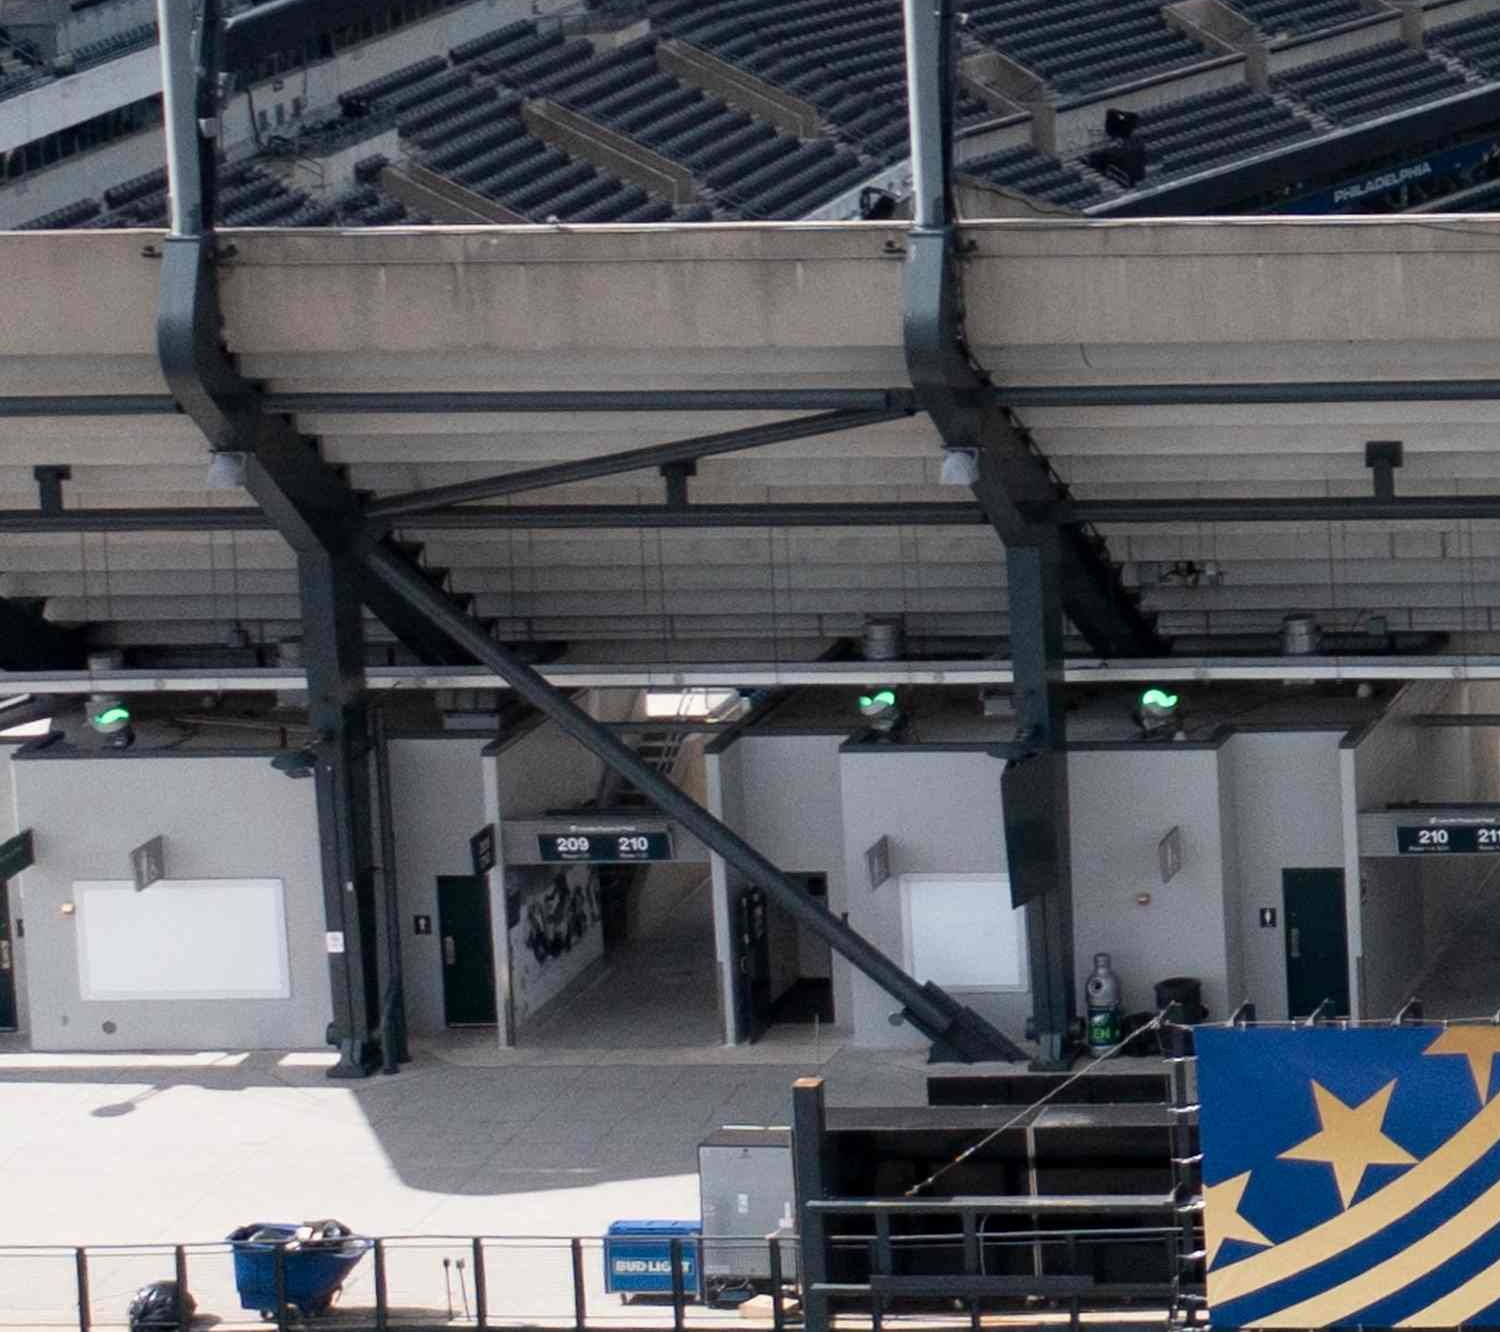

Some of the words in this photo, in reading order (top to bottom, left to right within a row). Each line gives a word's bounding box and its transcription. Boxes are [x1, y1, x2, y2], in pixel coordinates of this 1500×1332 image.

[1333, 161, 1433, 204] PHILADELPHIA
[556, 836, 591, 852] 209
[618, 836, 649, 851] 210
[1417, 829, 1449, 844] 210
[615, 1259, 647, 1273] BUD
[647, 1259, 691, 1273] LIGT
